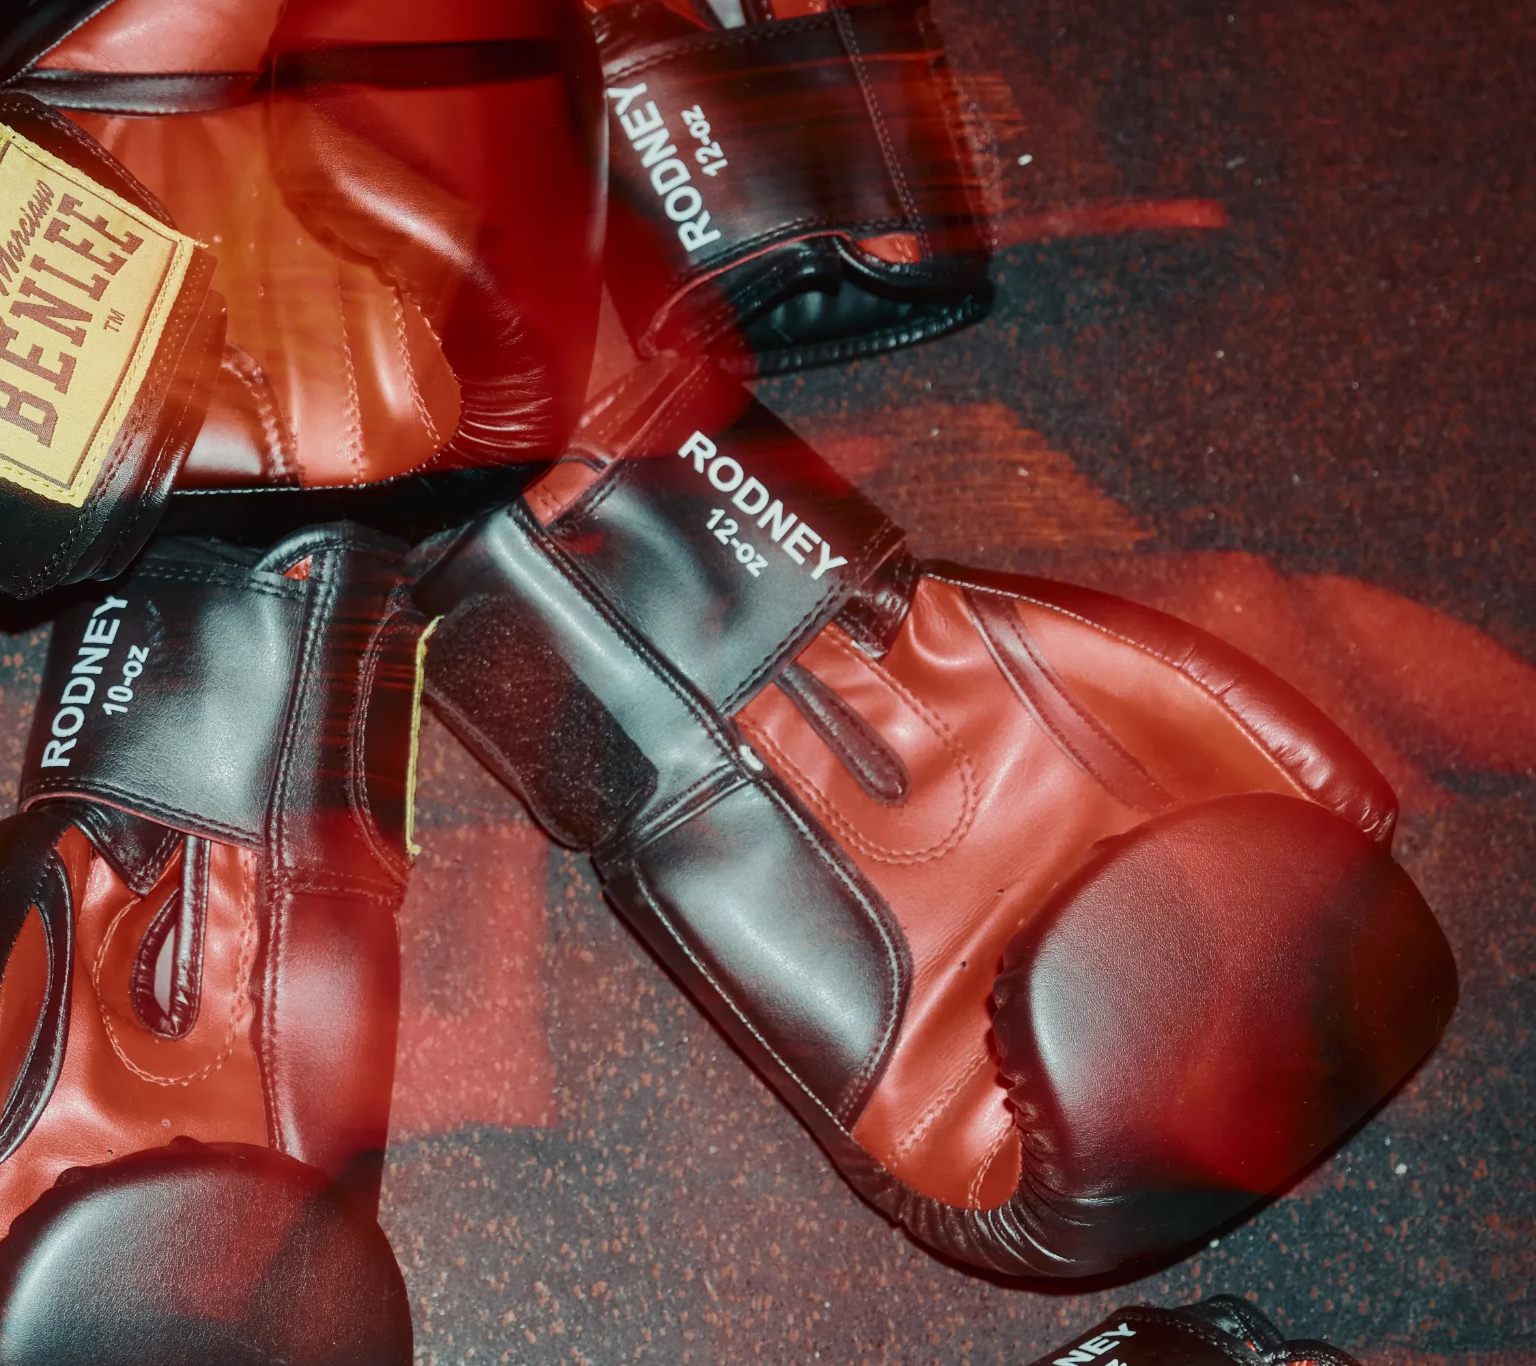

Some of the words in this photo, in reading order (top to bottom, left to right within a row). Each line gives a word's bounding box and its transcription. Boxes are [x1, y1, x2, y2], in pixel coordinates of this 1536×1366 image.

[606, 82, 722, 252] RODNEY
[677, 430, 848, 581] RODNEY
[40, 595, 129, 768] RODNEY
